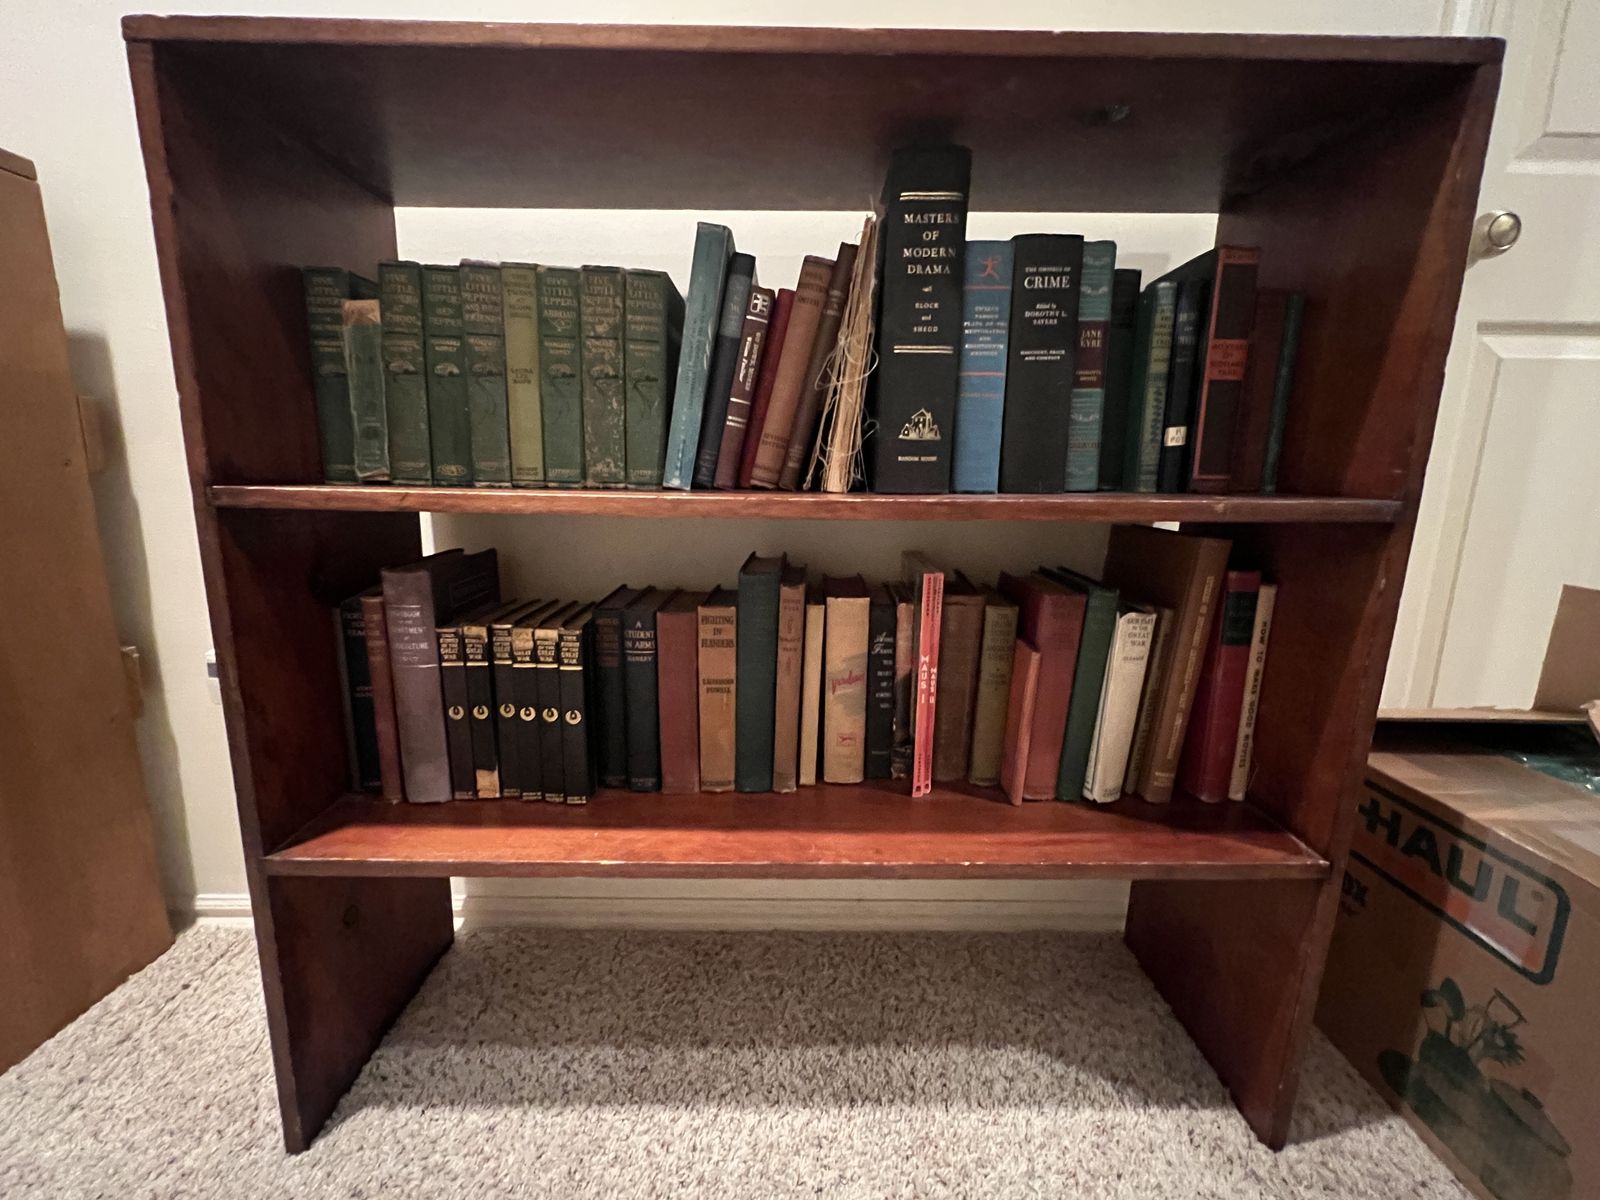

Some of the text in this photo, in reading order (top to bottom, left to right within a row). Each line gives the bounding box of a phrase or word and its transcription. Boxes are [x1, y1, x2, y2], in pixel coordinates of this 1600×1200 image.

[904, 213, 960, 224] MASTERS
[923, 231, 939, 241] OF
[902, 248, 957, 258] MODERN
[907, 265, 950, 275] DRAMA
[1024, 275, 1071, 289] CRIME
[1081, 329, 1102, 338] JANE
[1080, 338, 1102, 348] EYRE
[635, 620, 642, 629] A
[701, 615, 734, 625] FIGHTING
[624, 630, 656, 639] STUDENT
[713, 627, 722, 636] IN
[634, 640, 656, 649] ARMS
[701, 638, 735, 648] FLANDERS
[920, 656, 930, 689] MAUS
